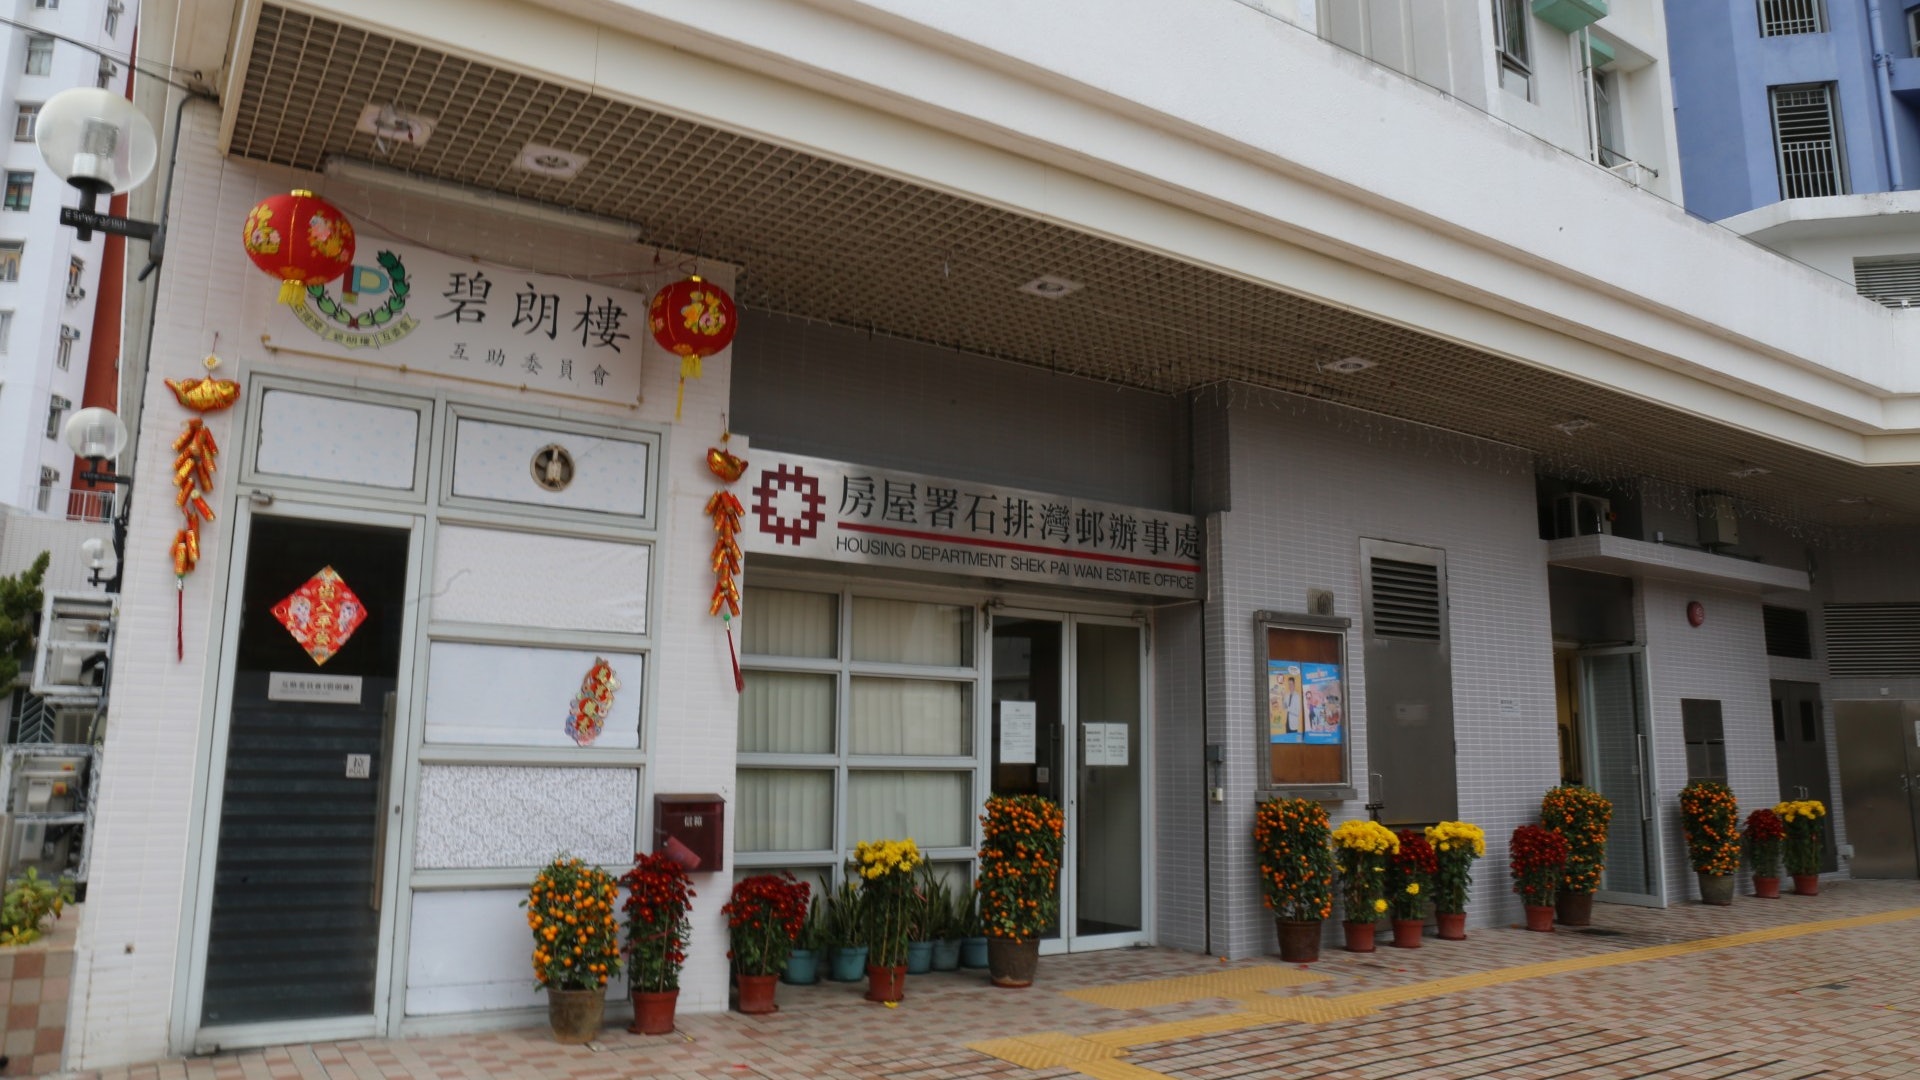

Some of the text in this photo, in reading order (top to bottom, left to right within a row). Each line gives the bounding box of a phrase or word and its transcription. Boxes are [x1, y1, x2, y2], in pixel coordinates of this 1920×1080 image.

[434, 270, 632, 354] 碧朗樓
[449, 341, 611, 388] 互助委員會
[837, 475, 1202, 561] 房屋署石排灣邨辦事處
[836, 535, 1195, 590] HOUSING DEPARTMENT SHEK PAI WAN ESTATE OFFICE
